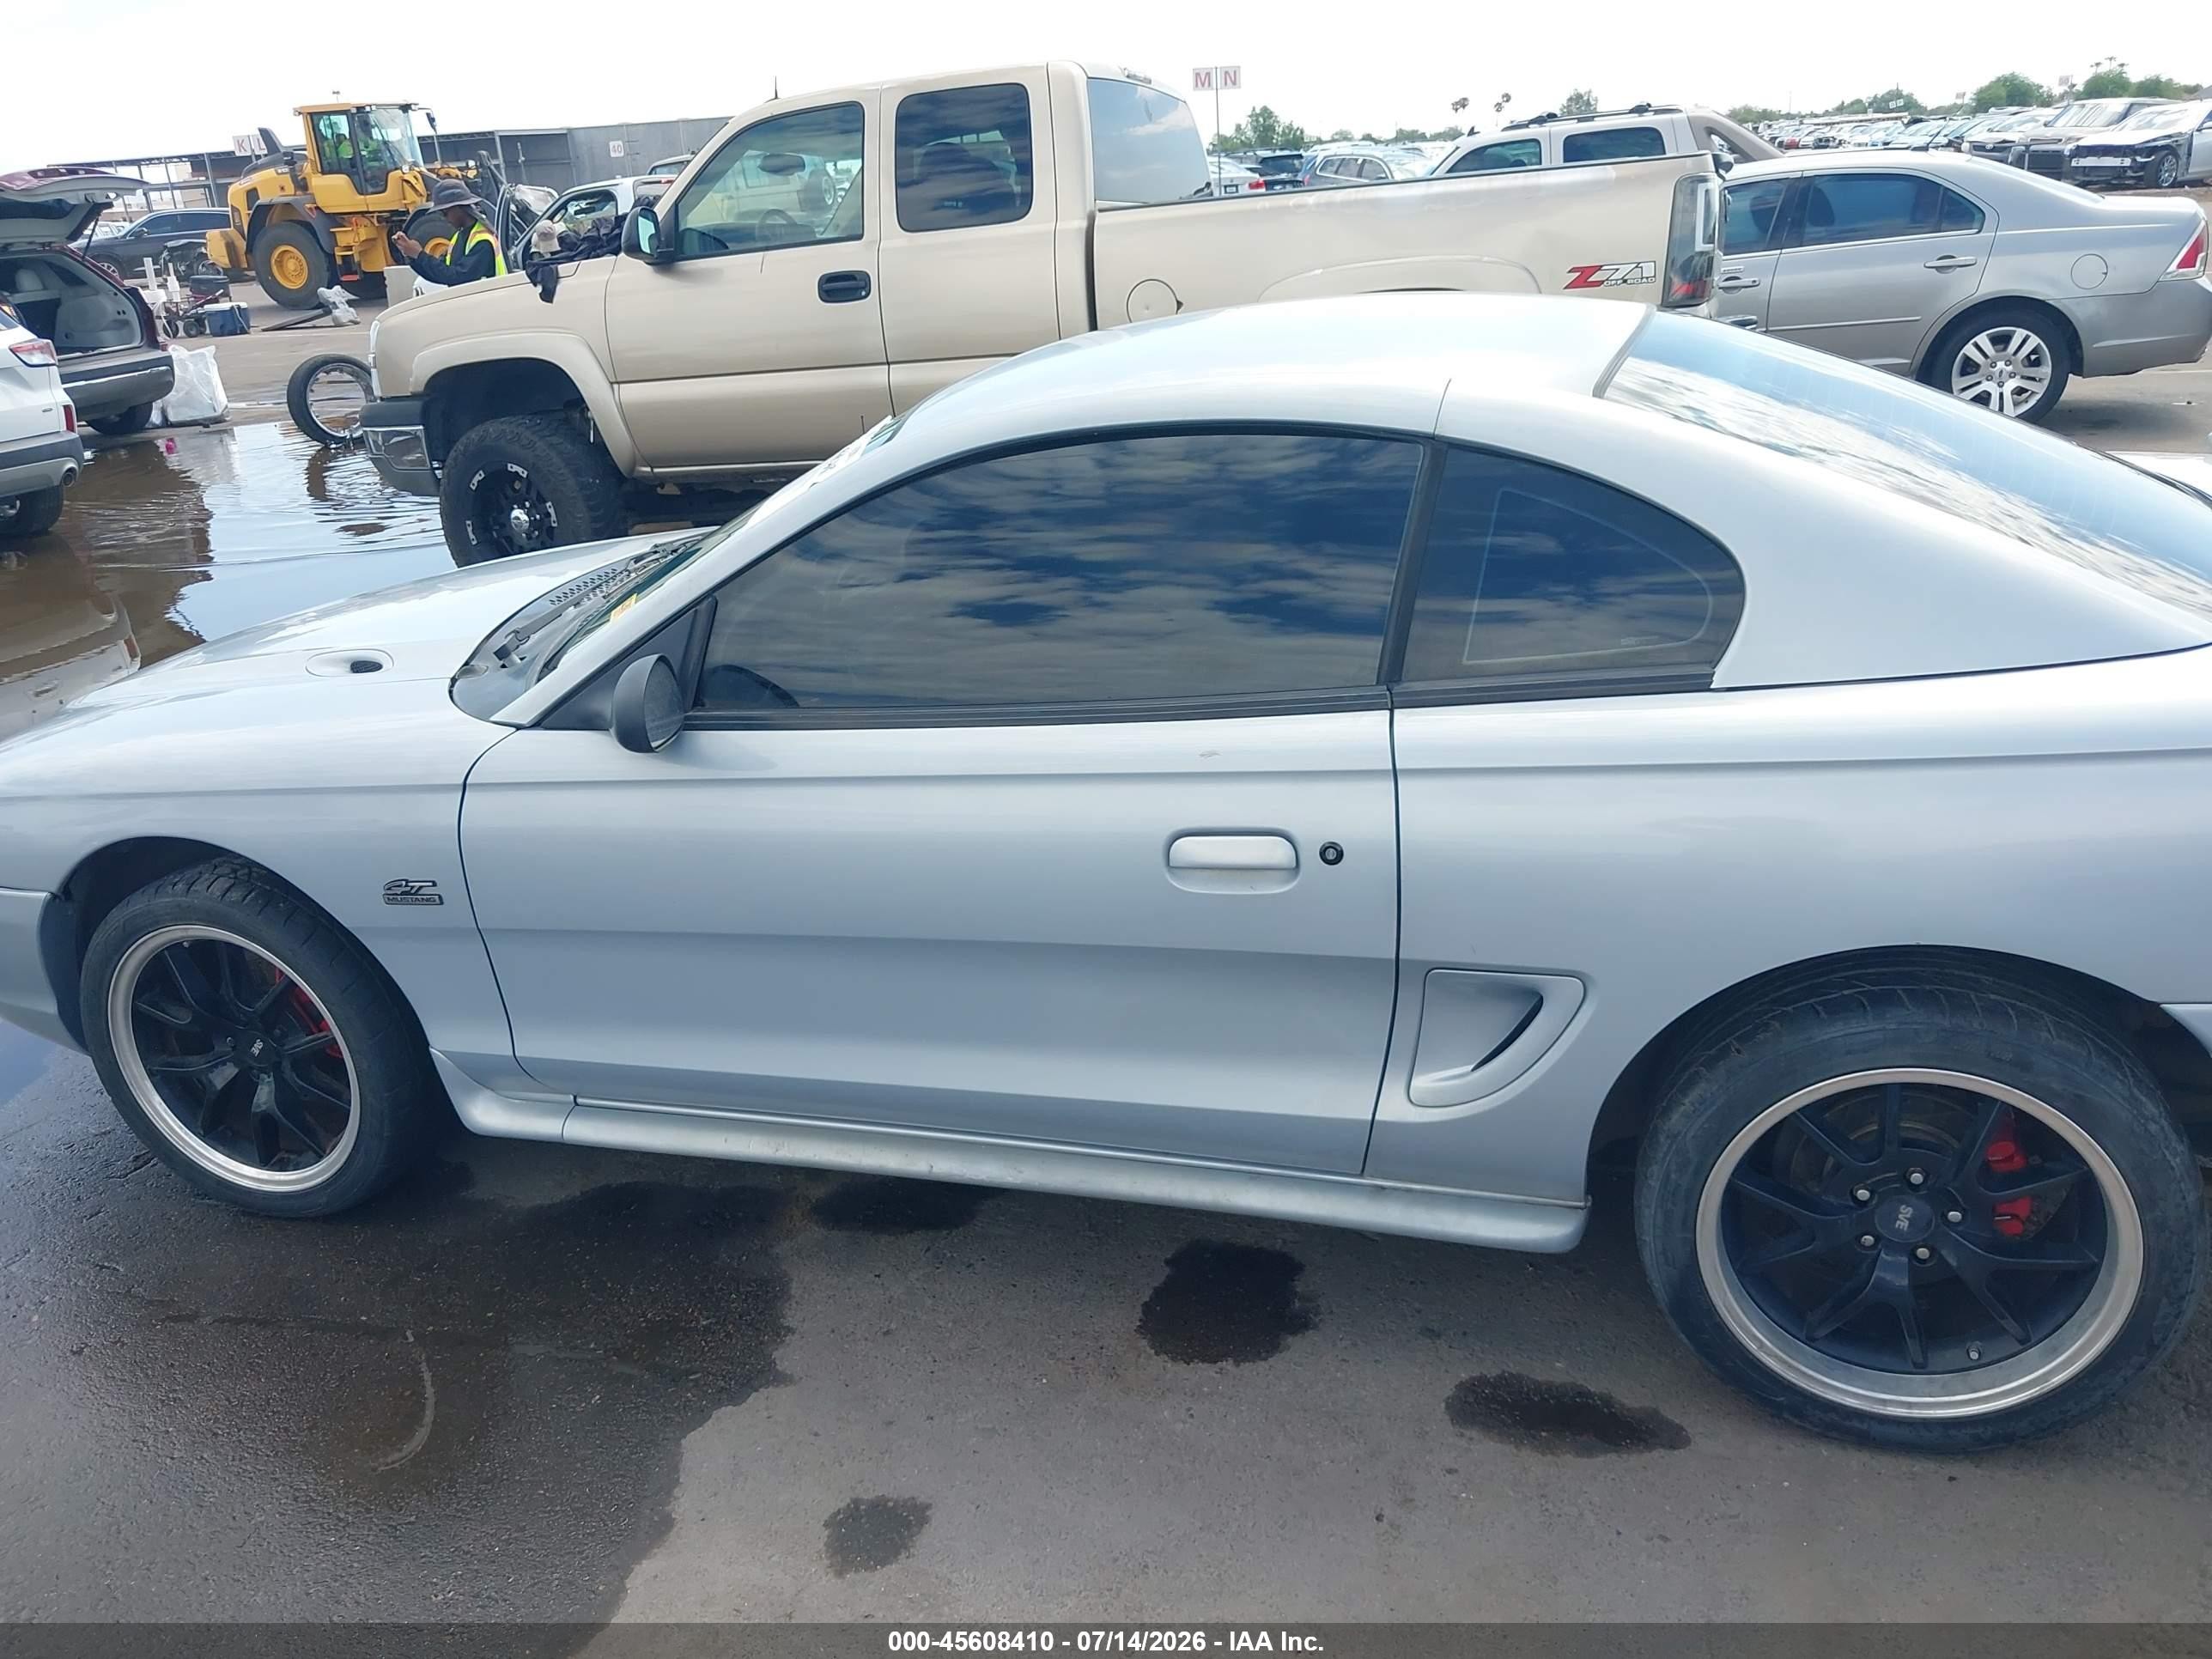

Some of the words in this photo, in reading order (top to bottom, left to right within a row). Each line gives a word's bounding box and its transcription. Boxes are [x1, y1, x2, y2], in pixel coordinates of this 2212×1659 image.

[1195, 71, 1211, 88] M
[1224, 70, 1237, 86] N
[237, 139, 247, 152] K
[257, 138, 266, 151] L
[1563, 260, 1656, 289] Z71
[1627, 276, 1656, 285] ROAD
[383, 878, 437, 895] GT
[1895, 1205, 1913, 1231] SVE
